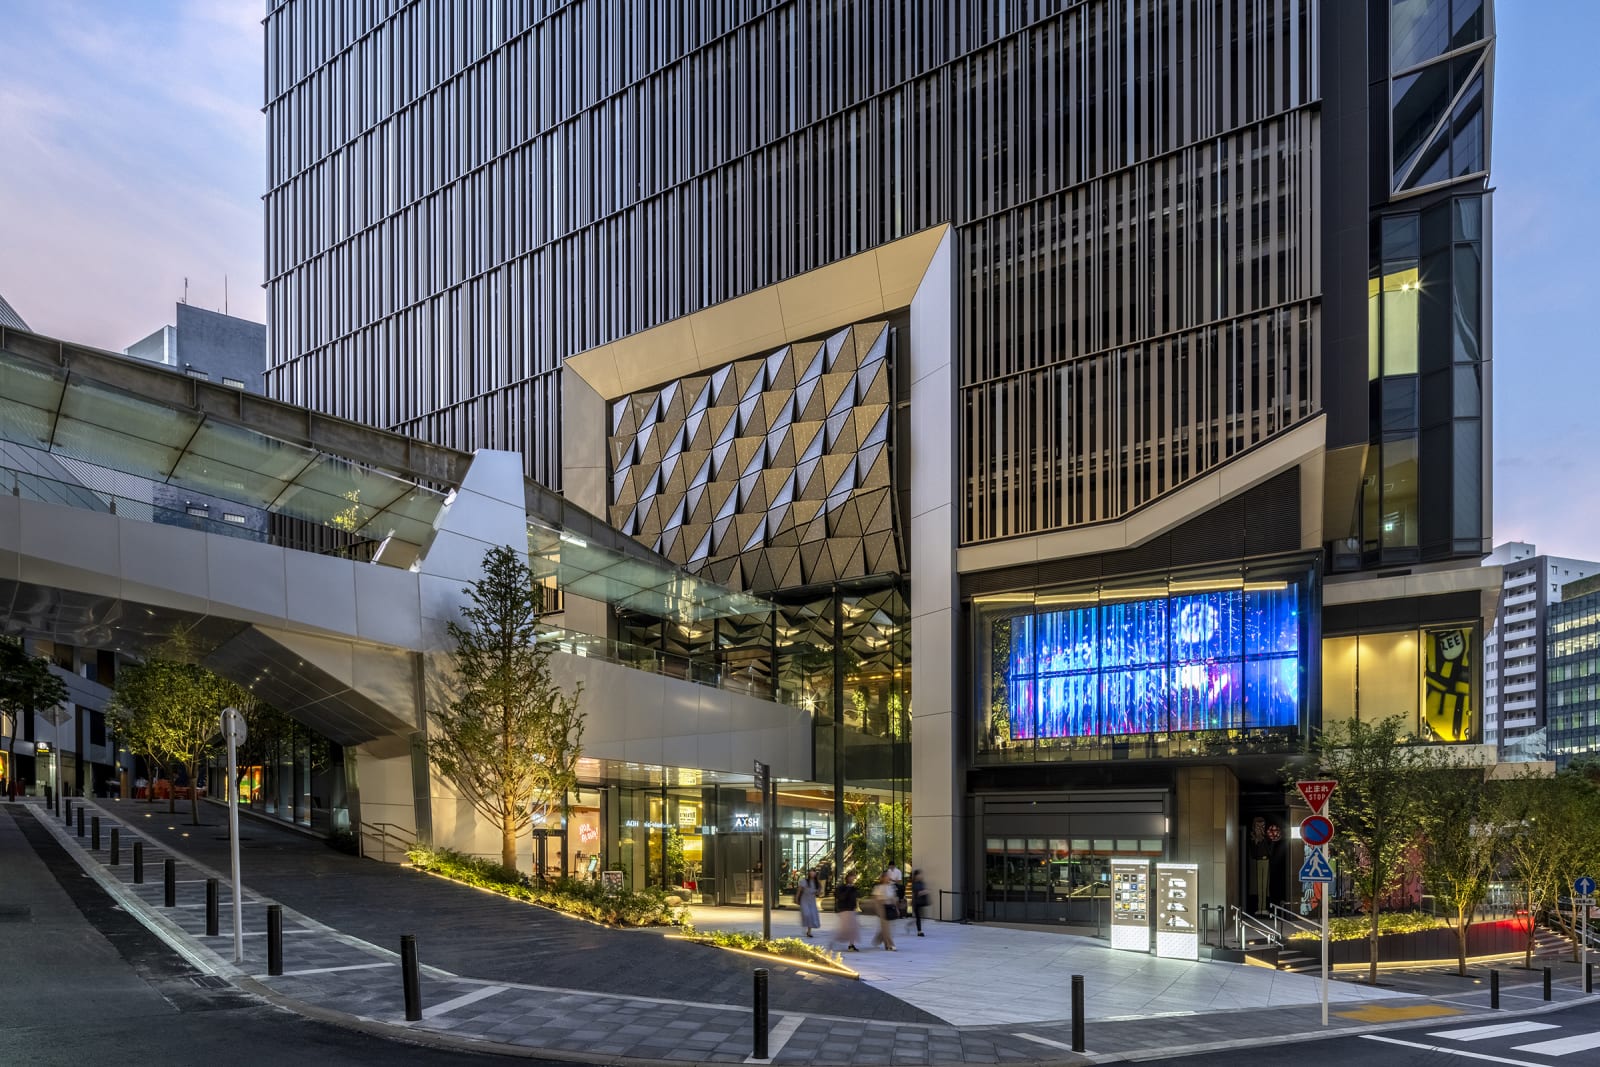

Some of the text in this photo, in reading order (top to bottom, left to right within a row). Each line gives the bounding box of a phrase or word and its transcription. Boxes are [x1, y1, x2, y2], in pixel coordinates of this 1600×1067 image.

[1441, 635, 1461, 650] LEE
[1304, 784, 1329, 793] 止まれ
[1308, 793, 1326, 801] STOP
[735, 817, 759, 827] AXSH
